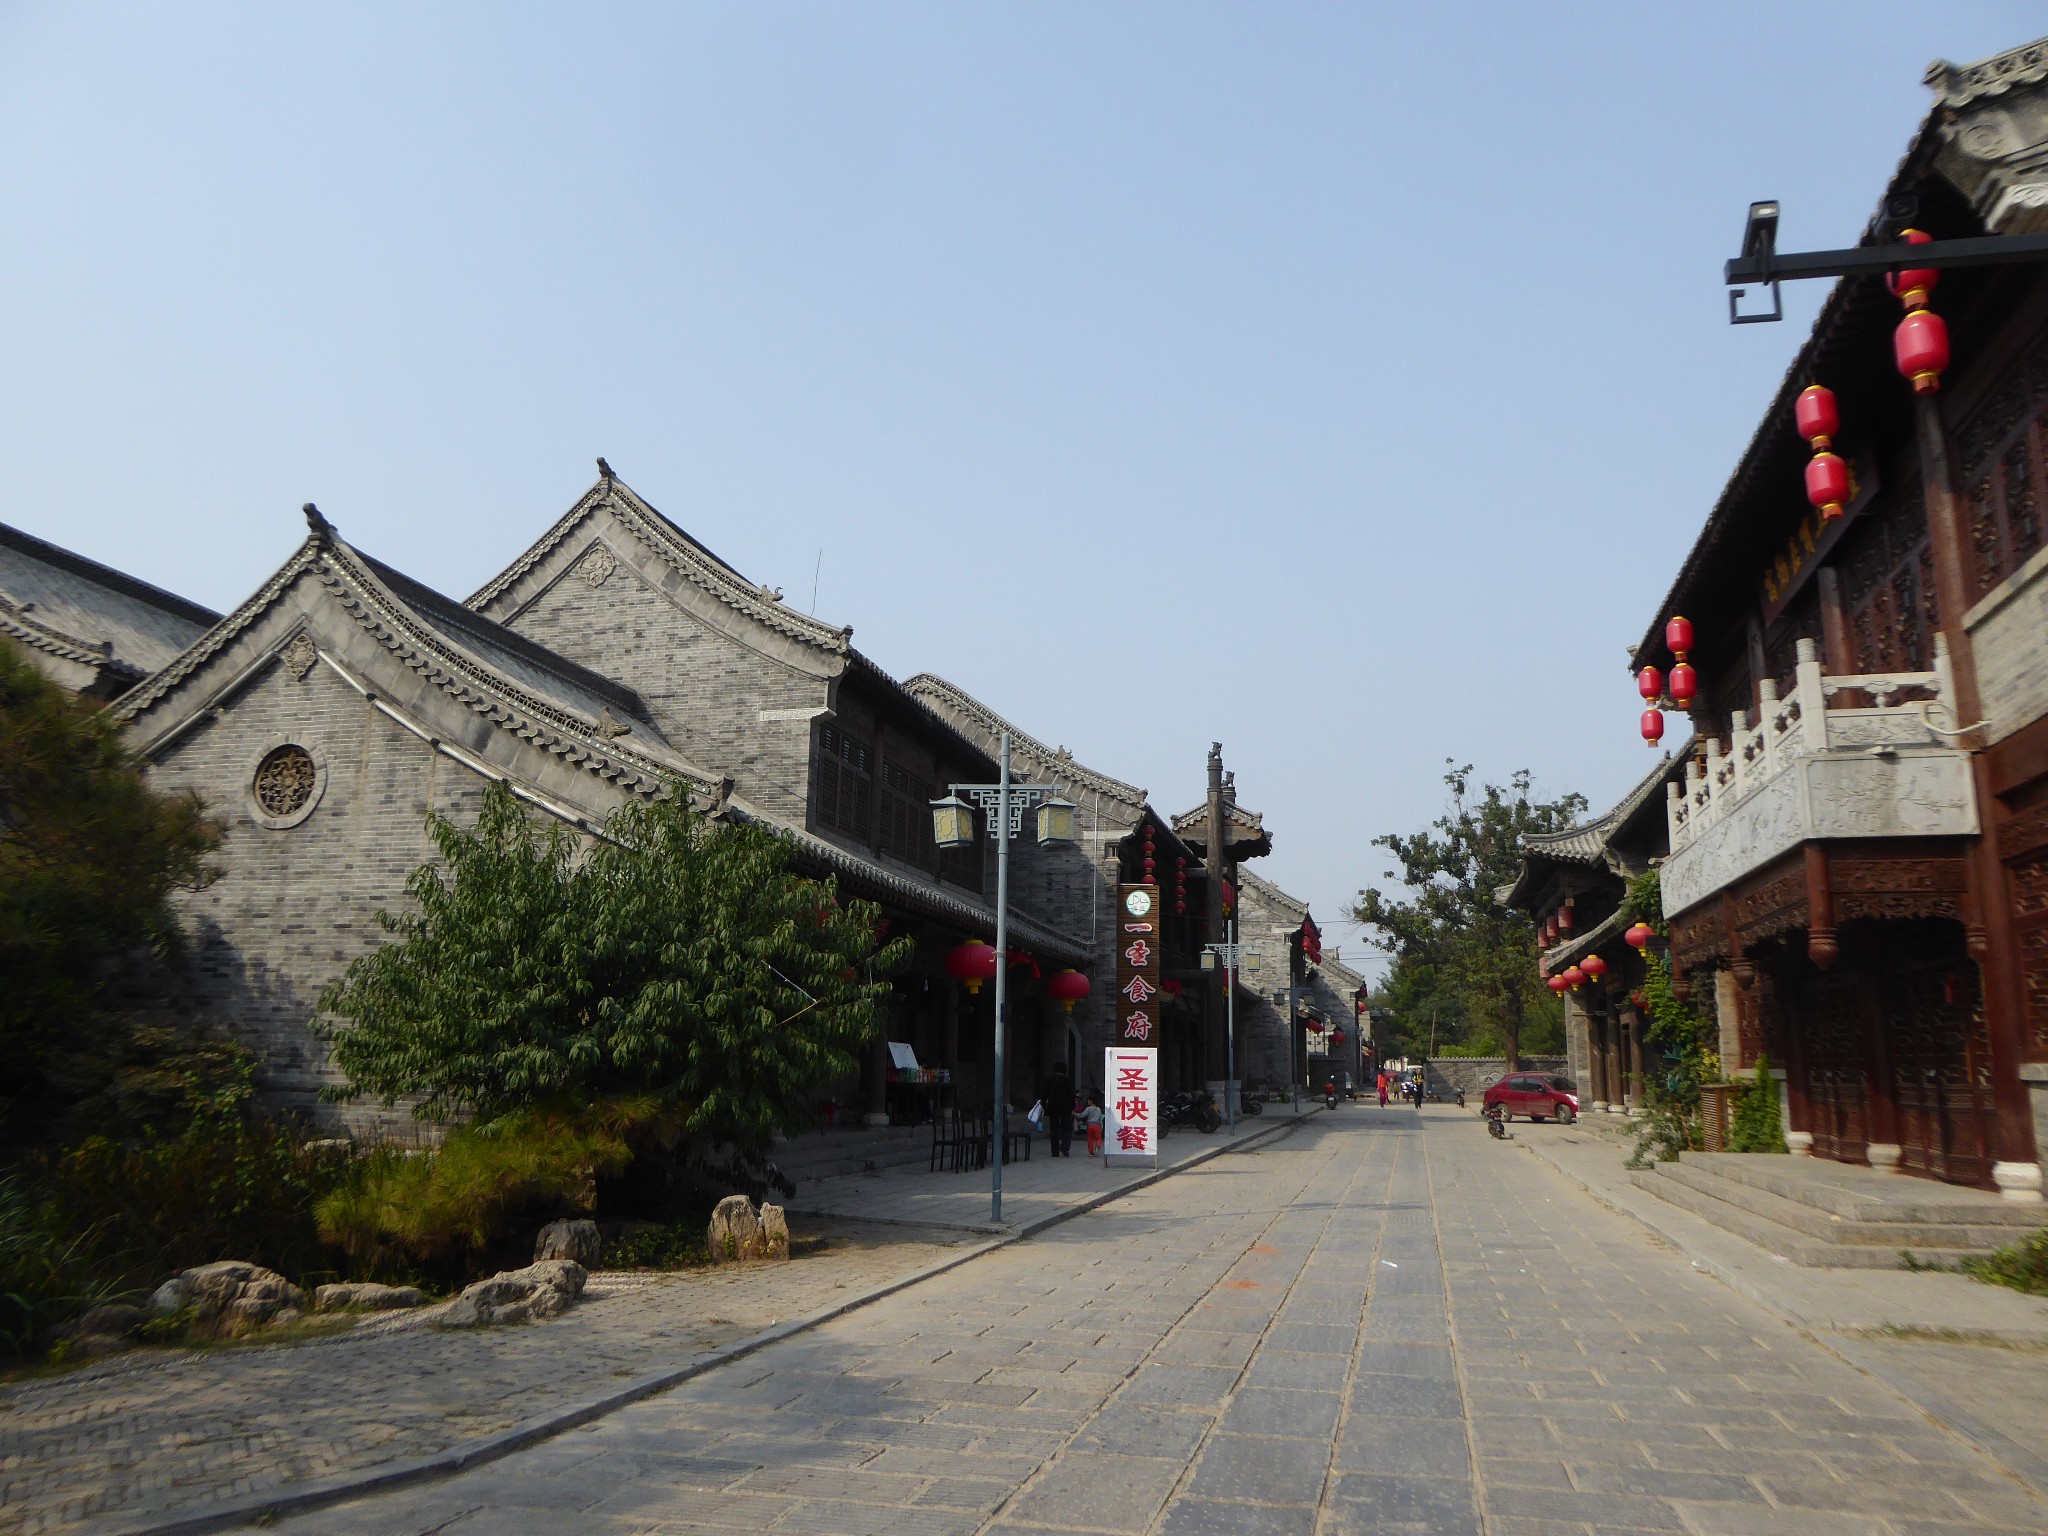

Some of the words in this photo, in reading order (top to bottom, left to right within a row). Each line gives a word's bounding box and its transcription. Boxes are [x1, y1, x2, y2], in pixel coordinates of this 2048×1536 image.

[1122, 923, 1156, 1041] 一圣食府
[1116, 1055, 1149, 1150] 一圣快餐
